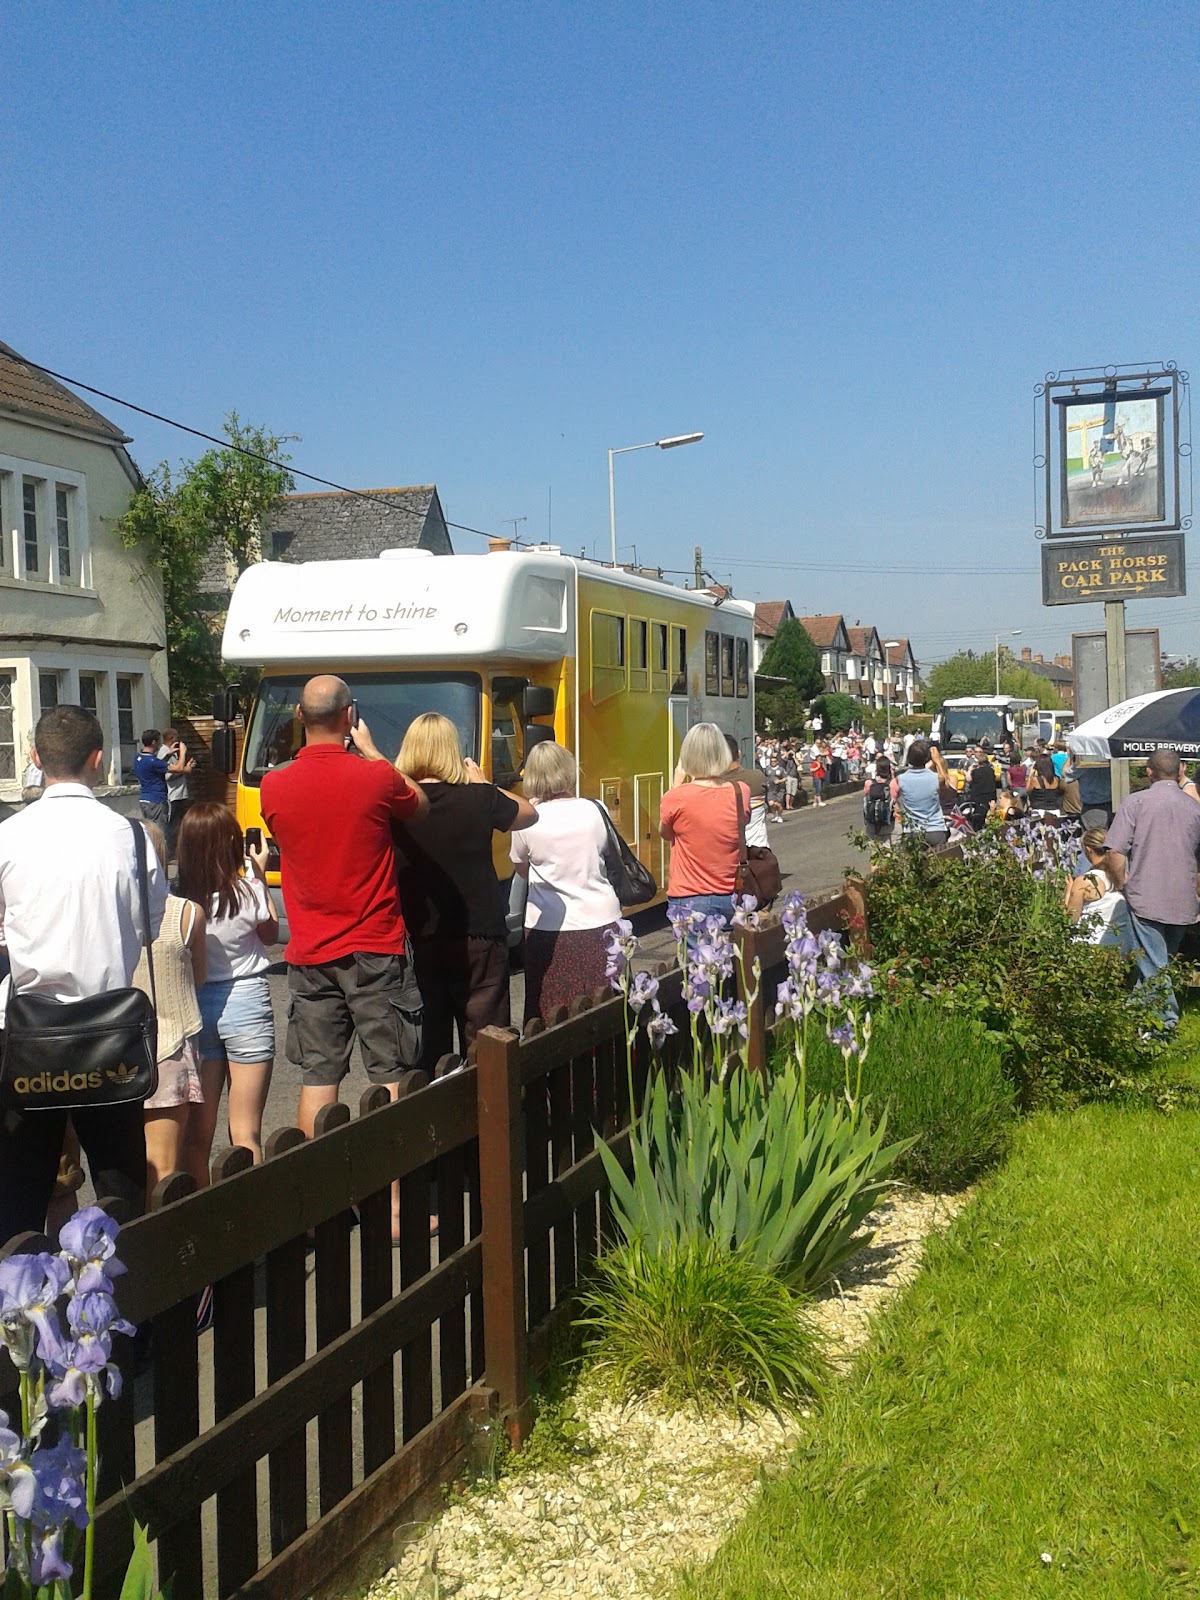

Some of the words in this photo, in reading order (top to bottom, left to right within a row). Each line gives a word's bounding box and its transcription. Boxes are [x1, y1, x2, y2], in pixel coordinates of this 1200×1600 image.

[1098, 546, 1126, 557] THE
[1058, 559, 1103, 573] PACK
[1110, 554, 1168, 569] HORSE
[1061, 573, 1104, 589] CAR
[1109, 568, 1168, 586] PARK
[273, 603, 353, 624] Moment
[357, 603, 378, 622] to
[382, 601, 438, 620] shine
[1123, 742, 1156, 752] MOLES
[13, 1070, 103, 1094] adidas
